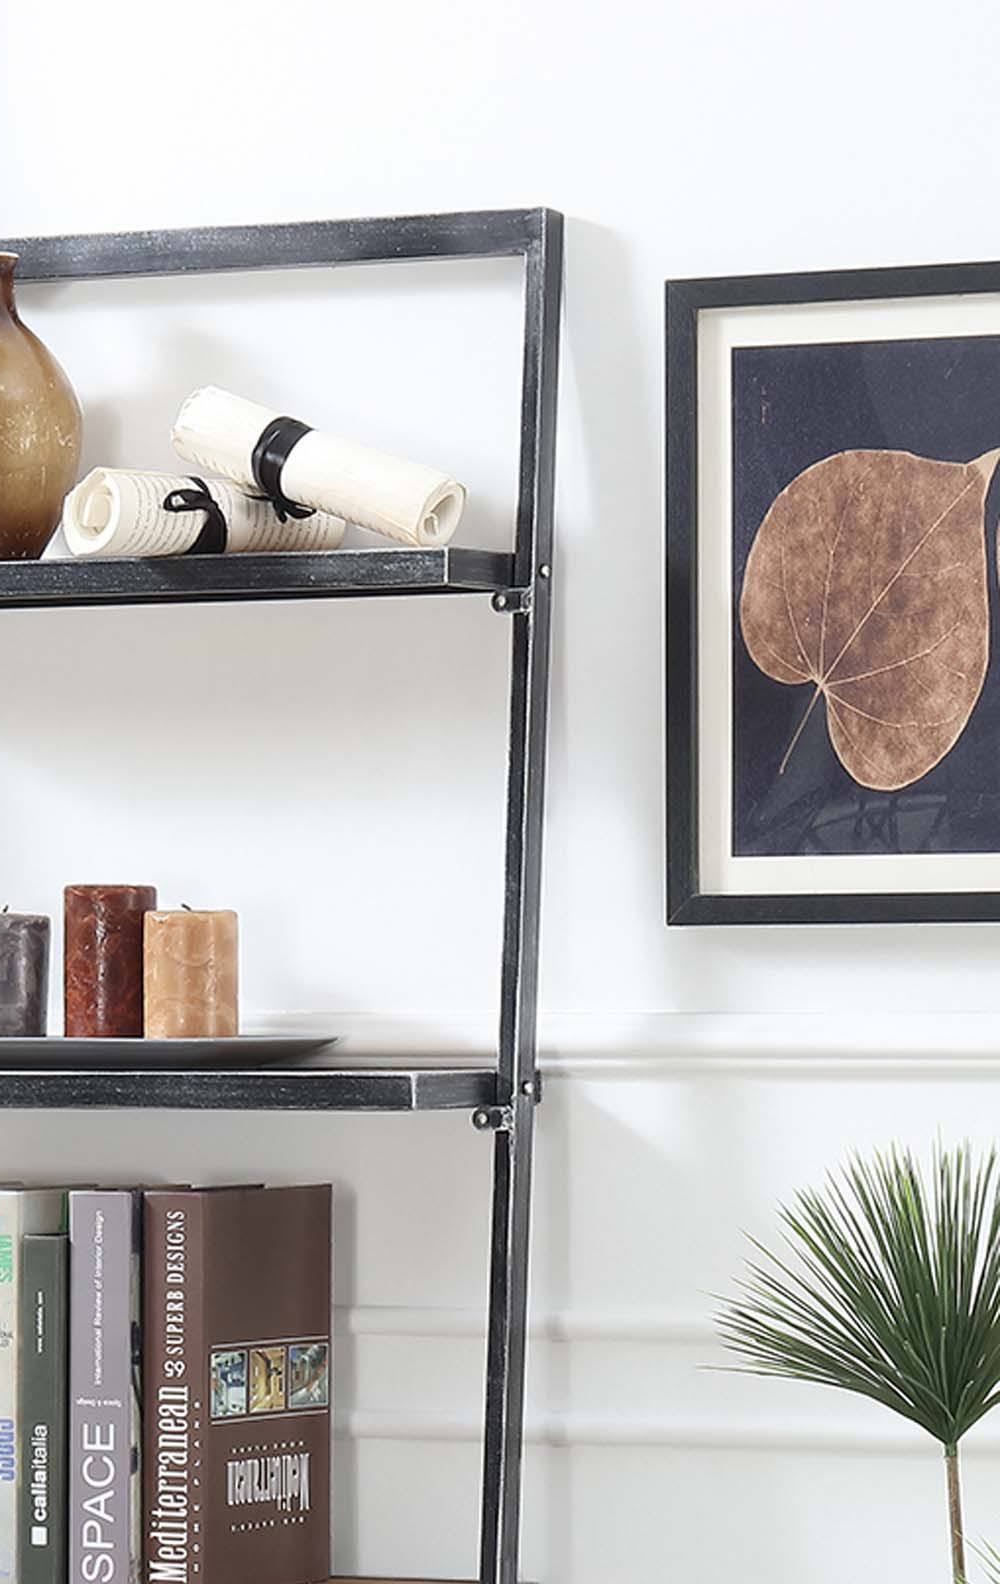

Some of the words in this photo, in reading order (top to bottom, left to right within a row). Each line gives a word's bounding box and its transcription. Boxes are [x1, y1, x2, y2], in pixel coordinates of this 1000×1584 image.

[94, 1210, 105, 1244] Design
[166, 1210, 185, 1283] DESIGNS
[94, 1292, 104, 1326] Review
[166, 1290, 185, 1355] SUPERB
[81, 1423, 115, 1583] SPACE
[149, 1385, 189, 1584] Mediterranean
